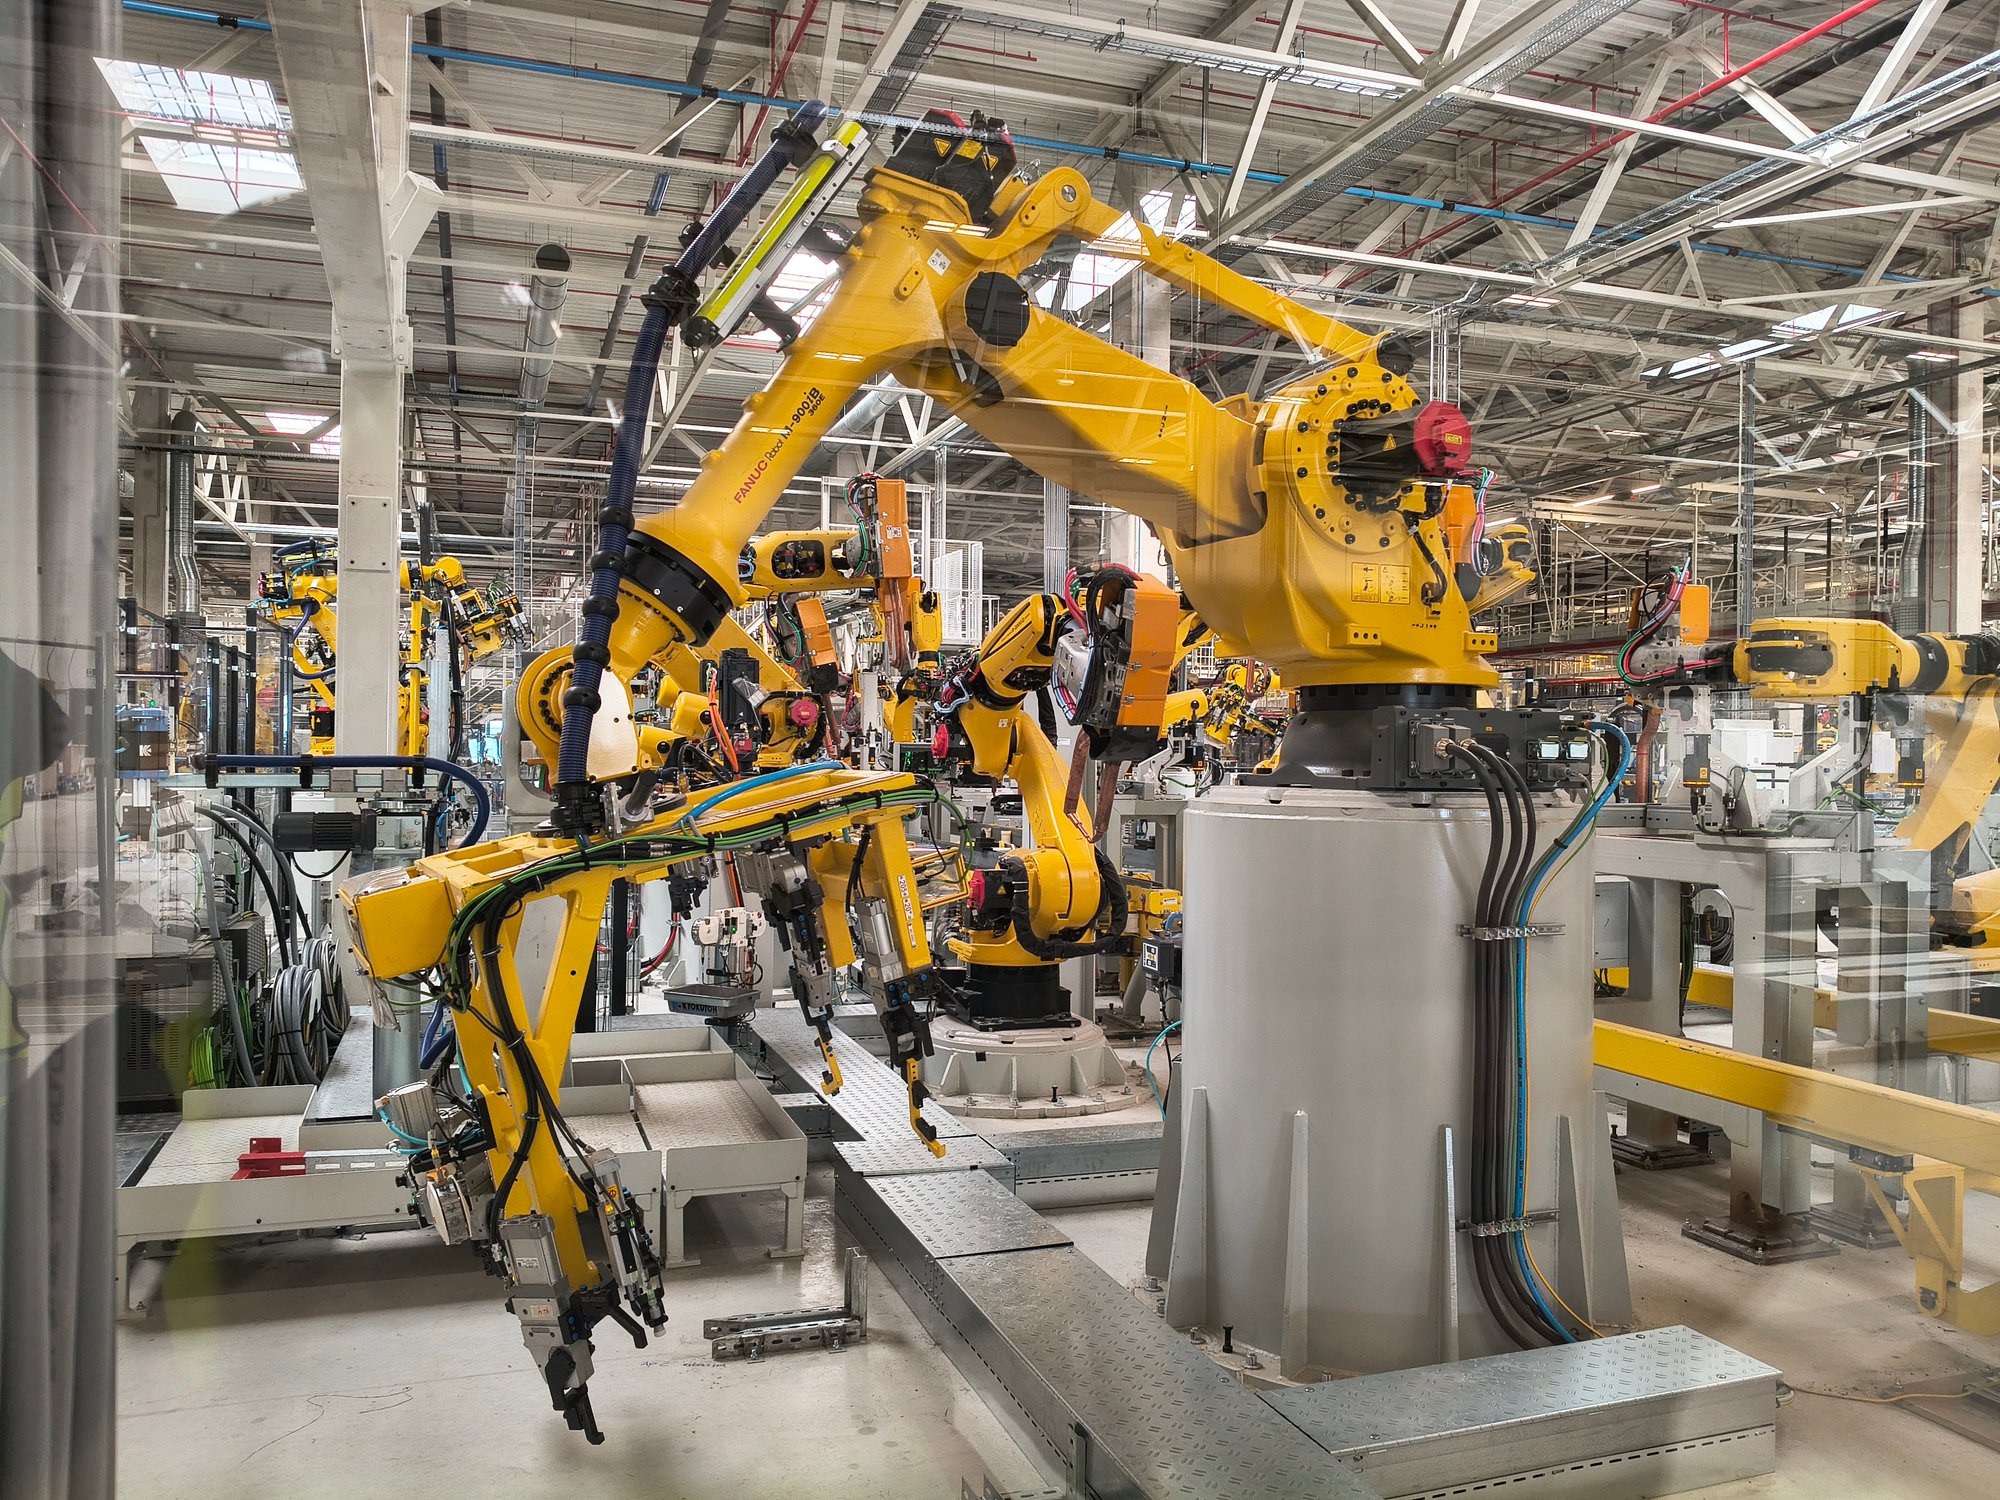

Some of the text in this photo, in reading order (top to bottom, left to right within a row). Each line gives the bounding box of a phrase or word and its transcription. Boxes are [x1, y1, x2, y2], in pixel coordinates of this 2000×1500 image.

[807, 393, 826, 417] 360E
[733, 459, 768, 504] FANUC
[899, 880, 908, 893] 205
[682, 1002, 718, 1013] KYOKUTOH
